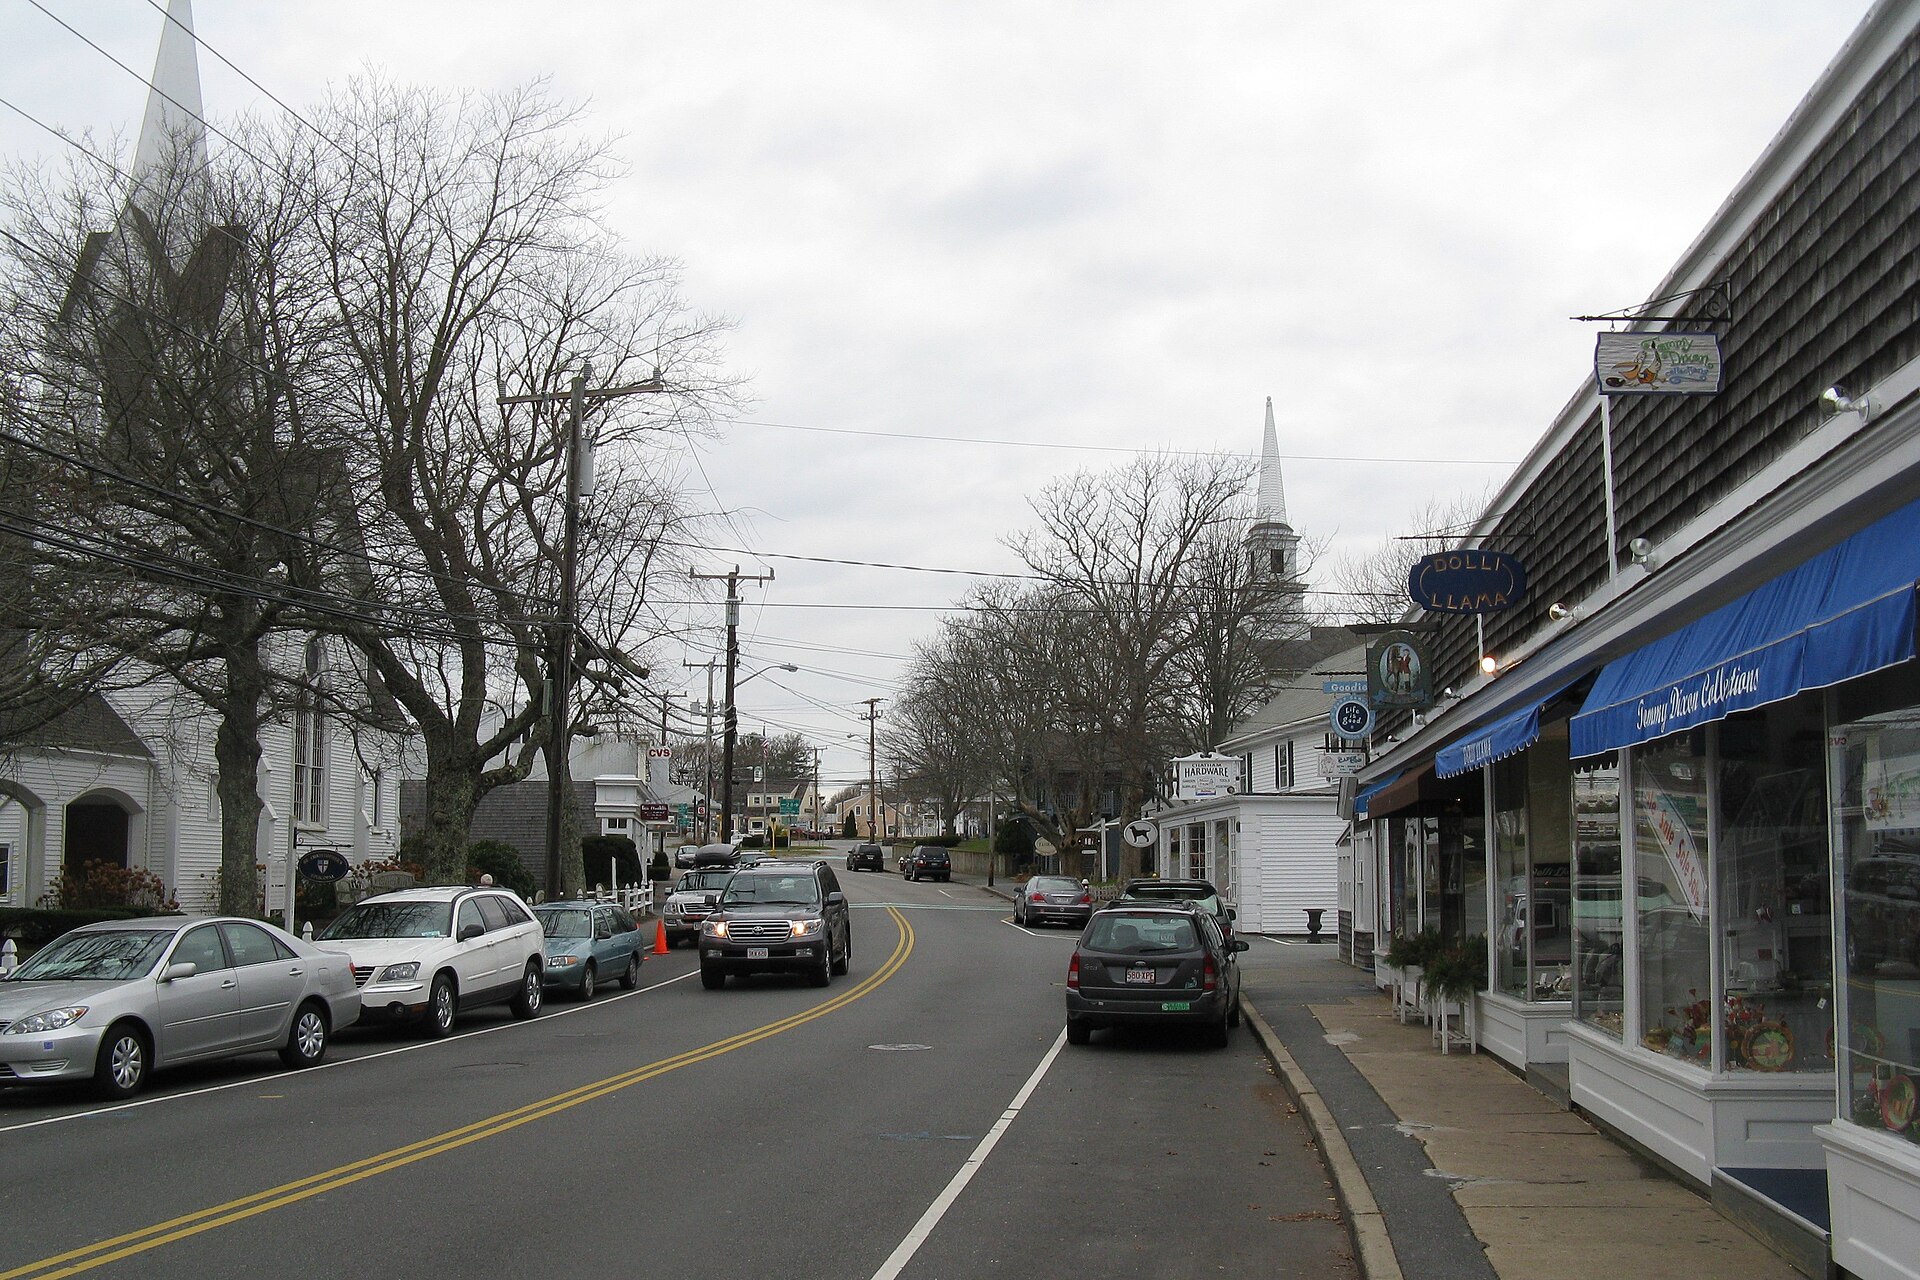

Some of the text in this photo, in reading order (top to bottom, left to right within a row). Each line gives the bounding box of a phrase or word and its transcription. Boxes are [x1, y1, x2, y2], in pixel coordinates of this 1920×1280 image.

[1434, 554, 1500, 572] DOLLI
[1431, 592, 1508, 610] LLAMA
[1669, 686, 1699, 720] Dixon
[1701, 665, 1760, 709] Collections
[1345, 706, 1360, 714] Life
[1342, 716, 1361, 725] good
[649, 749, 670, 757] CVS
[1184, 767, 1229, 778] HARDWARE
[1659, 809, 1675, 845] Sale
[1676, 839, 1690, 876] Sale
